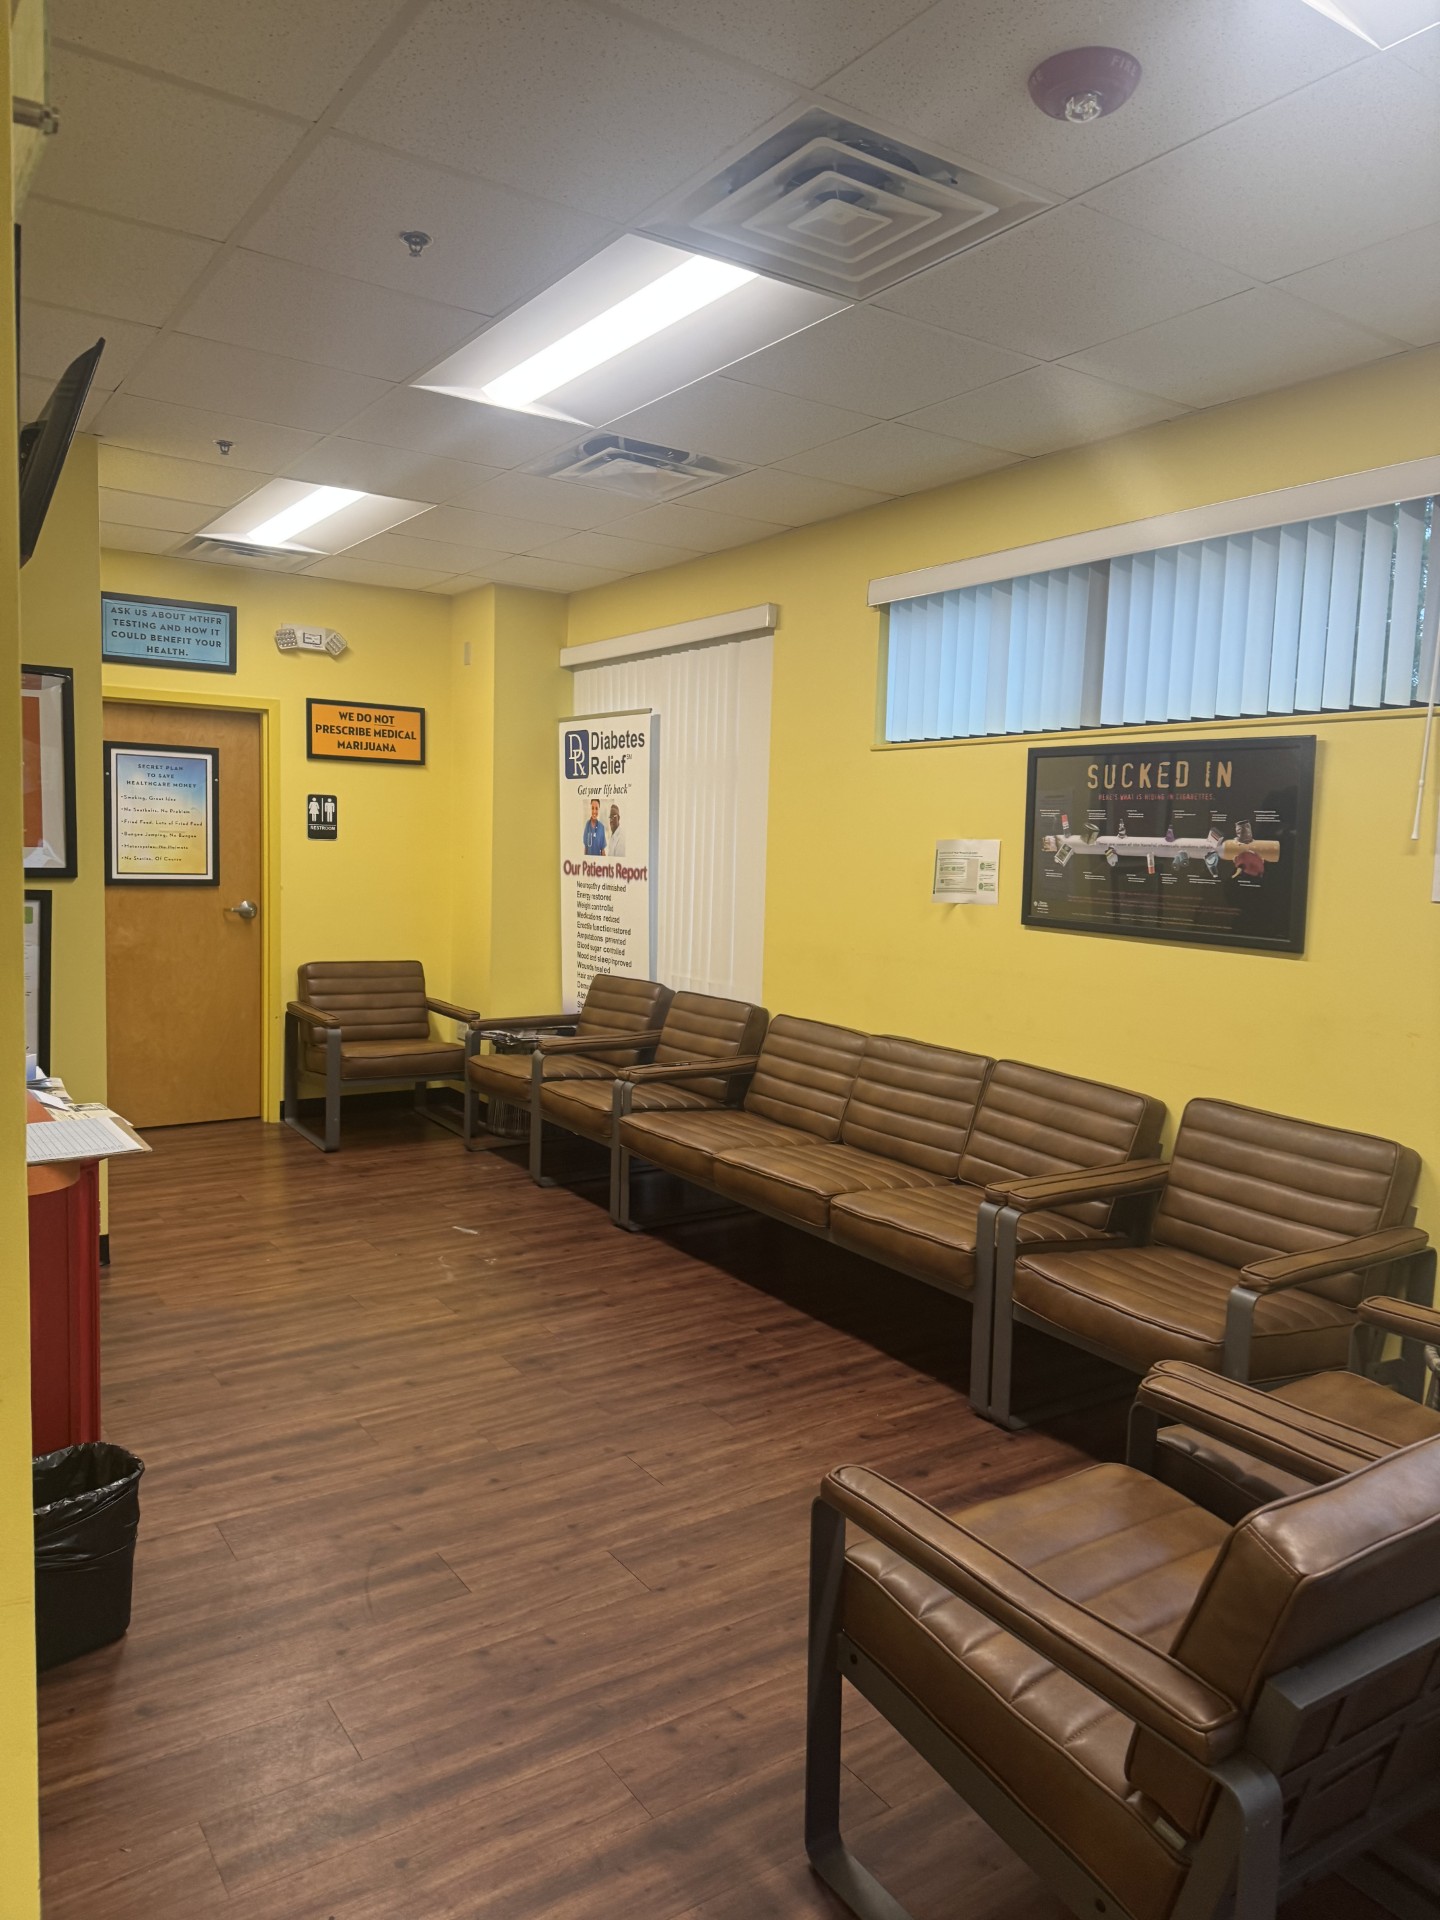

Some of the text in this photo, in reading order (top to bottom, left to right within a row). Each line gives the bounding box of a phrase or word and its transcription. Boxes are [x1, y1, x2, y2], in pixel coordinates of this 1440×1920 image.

[111, 606, 222, 625] ASK US ABOUT MTHFR
[113, 618, 156, 630] TESTING
[160, 624, 180, 632] AND
[184, 626, 207, 634] HOW
[111, 630, 222, 648] COULD BENEFIT YOUR
[146, 645, 189, 656] HEALTH.
[338, 711, 395, 725] WE DO NOT
[315, 724, 417, 740] PRESCRIBE MEDICAL
[591, 730, 645, 750] Diabetes
[337, 740, 397, 752] MARIJUANA
[1087, 760, 1232, 789] SUCKED IN
[126, 780, 171, 788] HEALTHCARE
[577, 784, 587, 796] Get
[587, 787, 602, 797] your
[603, 784, 612, 797] life
[1119, 793, 1134, 801] WHAT
[563, 859, 647, 883] Our Patients Report
